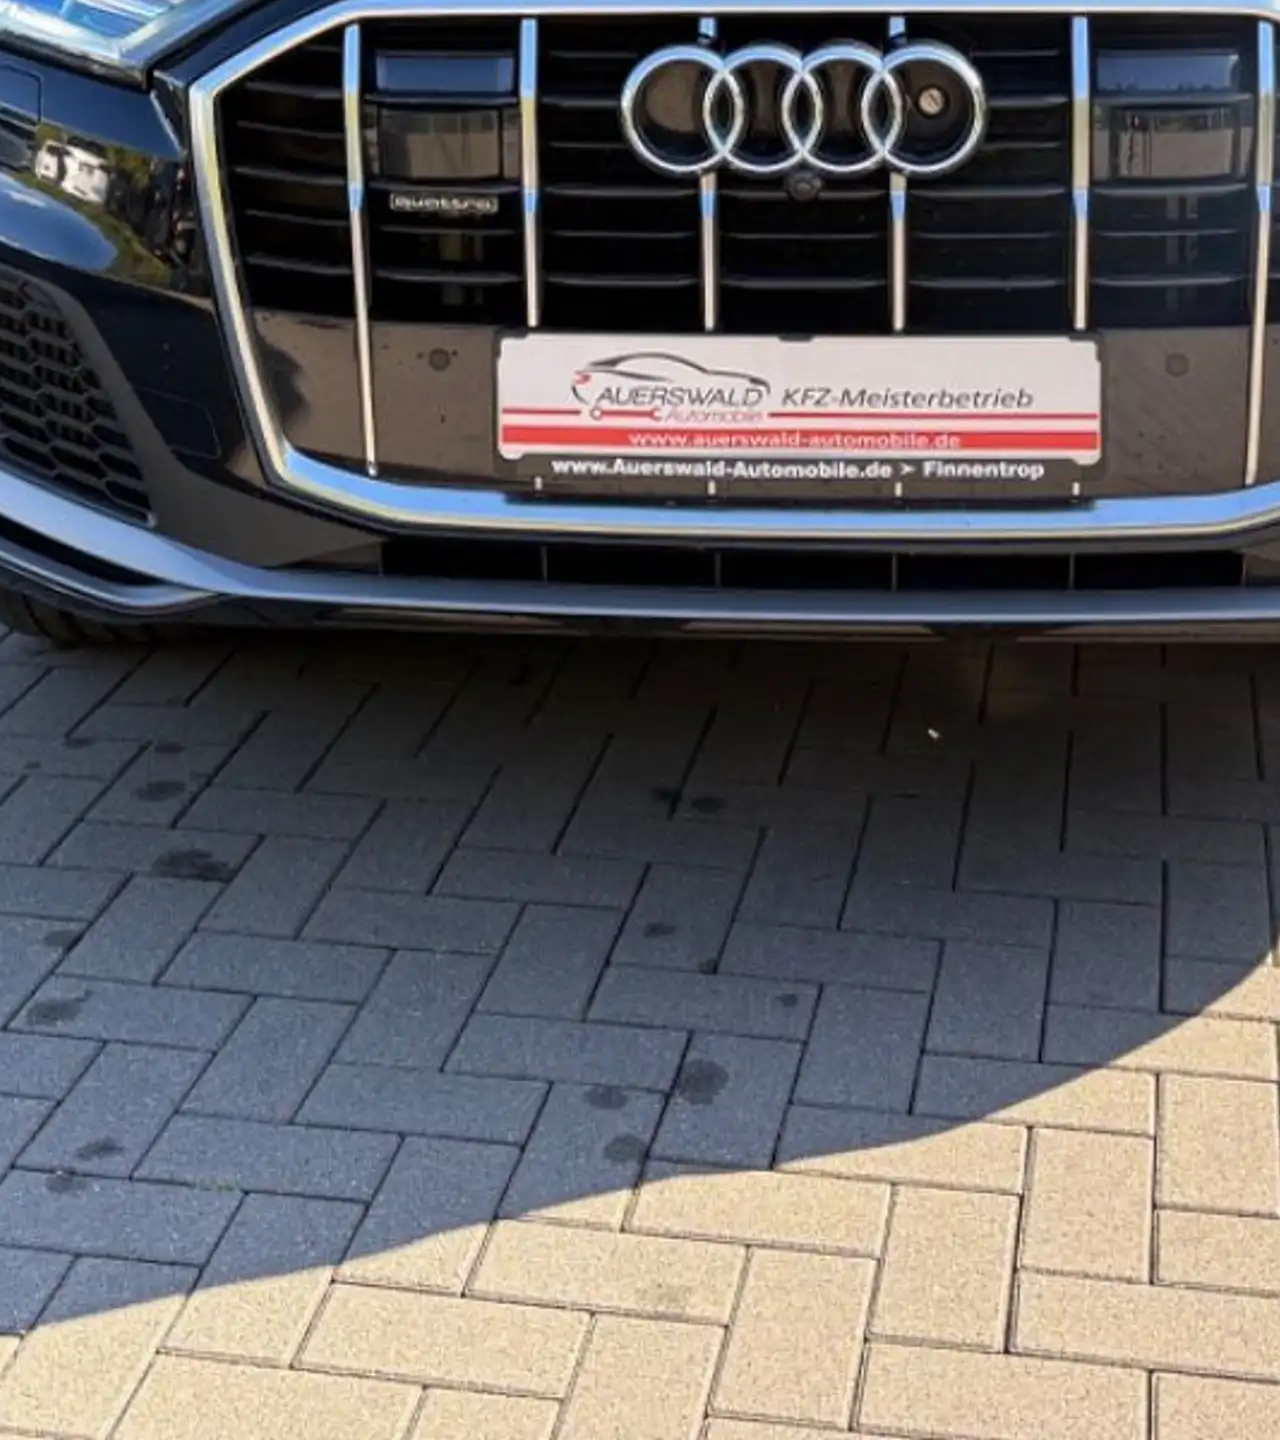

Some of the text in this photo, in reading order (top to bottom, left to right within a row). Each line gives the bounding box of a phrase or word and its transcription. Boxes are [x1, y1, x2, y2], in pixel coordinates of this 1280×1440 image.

[595, 386, 764, 407] AUERSWALD
[780, 387, 1035, 409] KFZ-Meisterbetrieb
[628, 431, 962, 449] www.auerswald-automobile.de
[551, 459, 893, 480] www.Auerswald-Automobile.de
[922, 460, 1046, 481] Finnentrop
